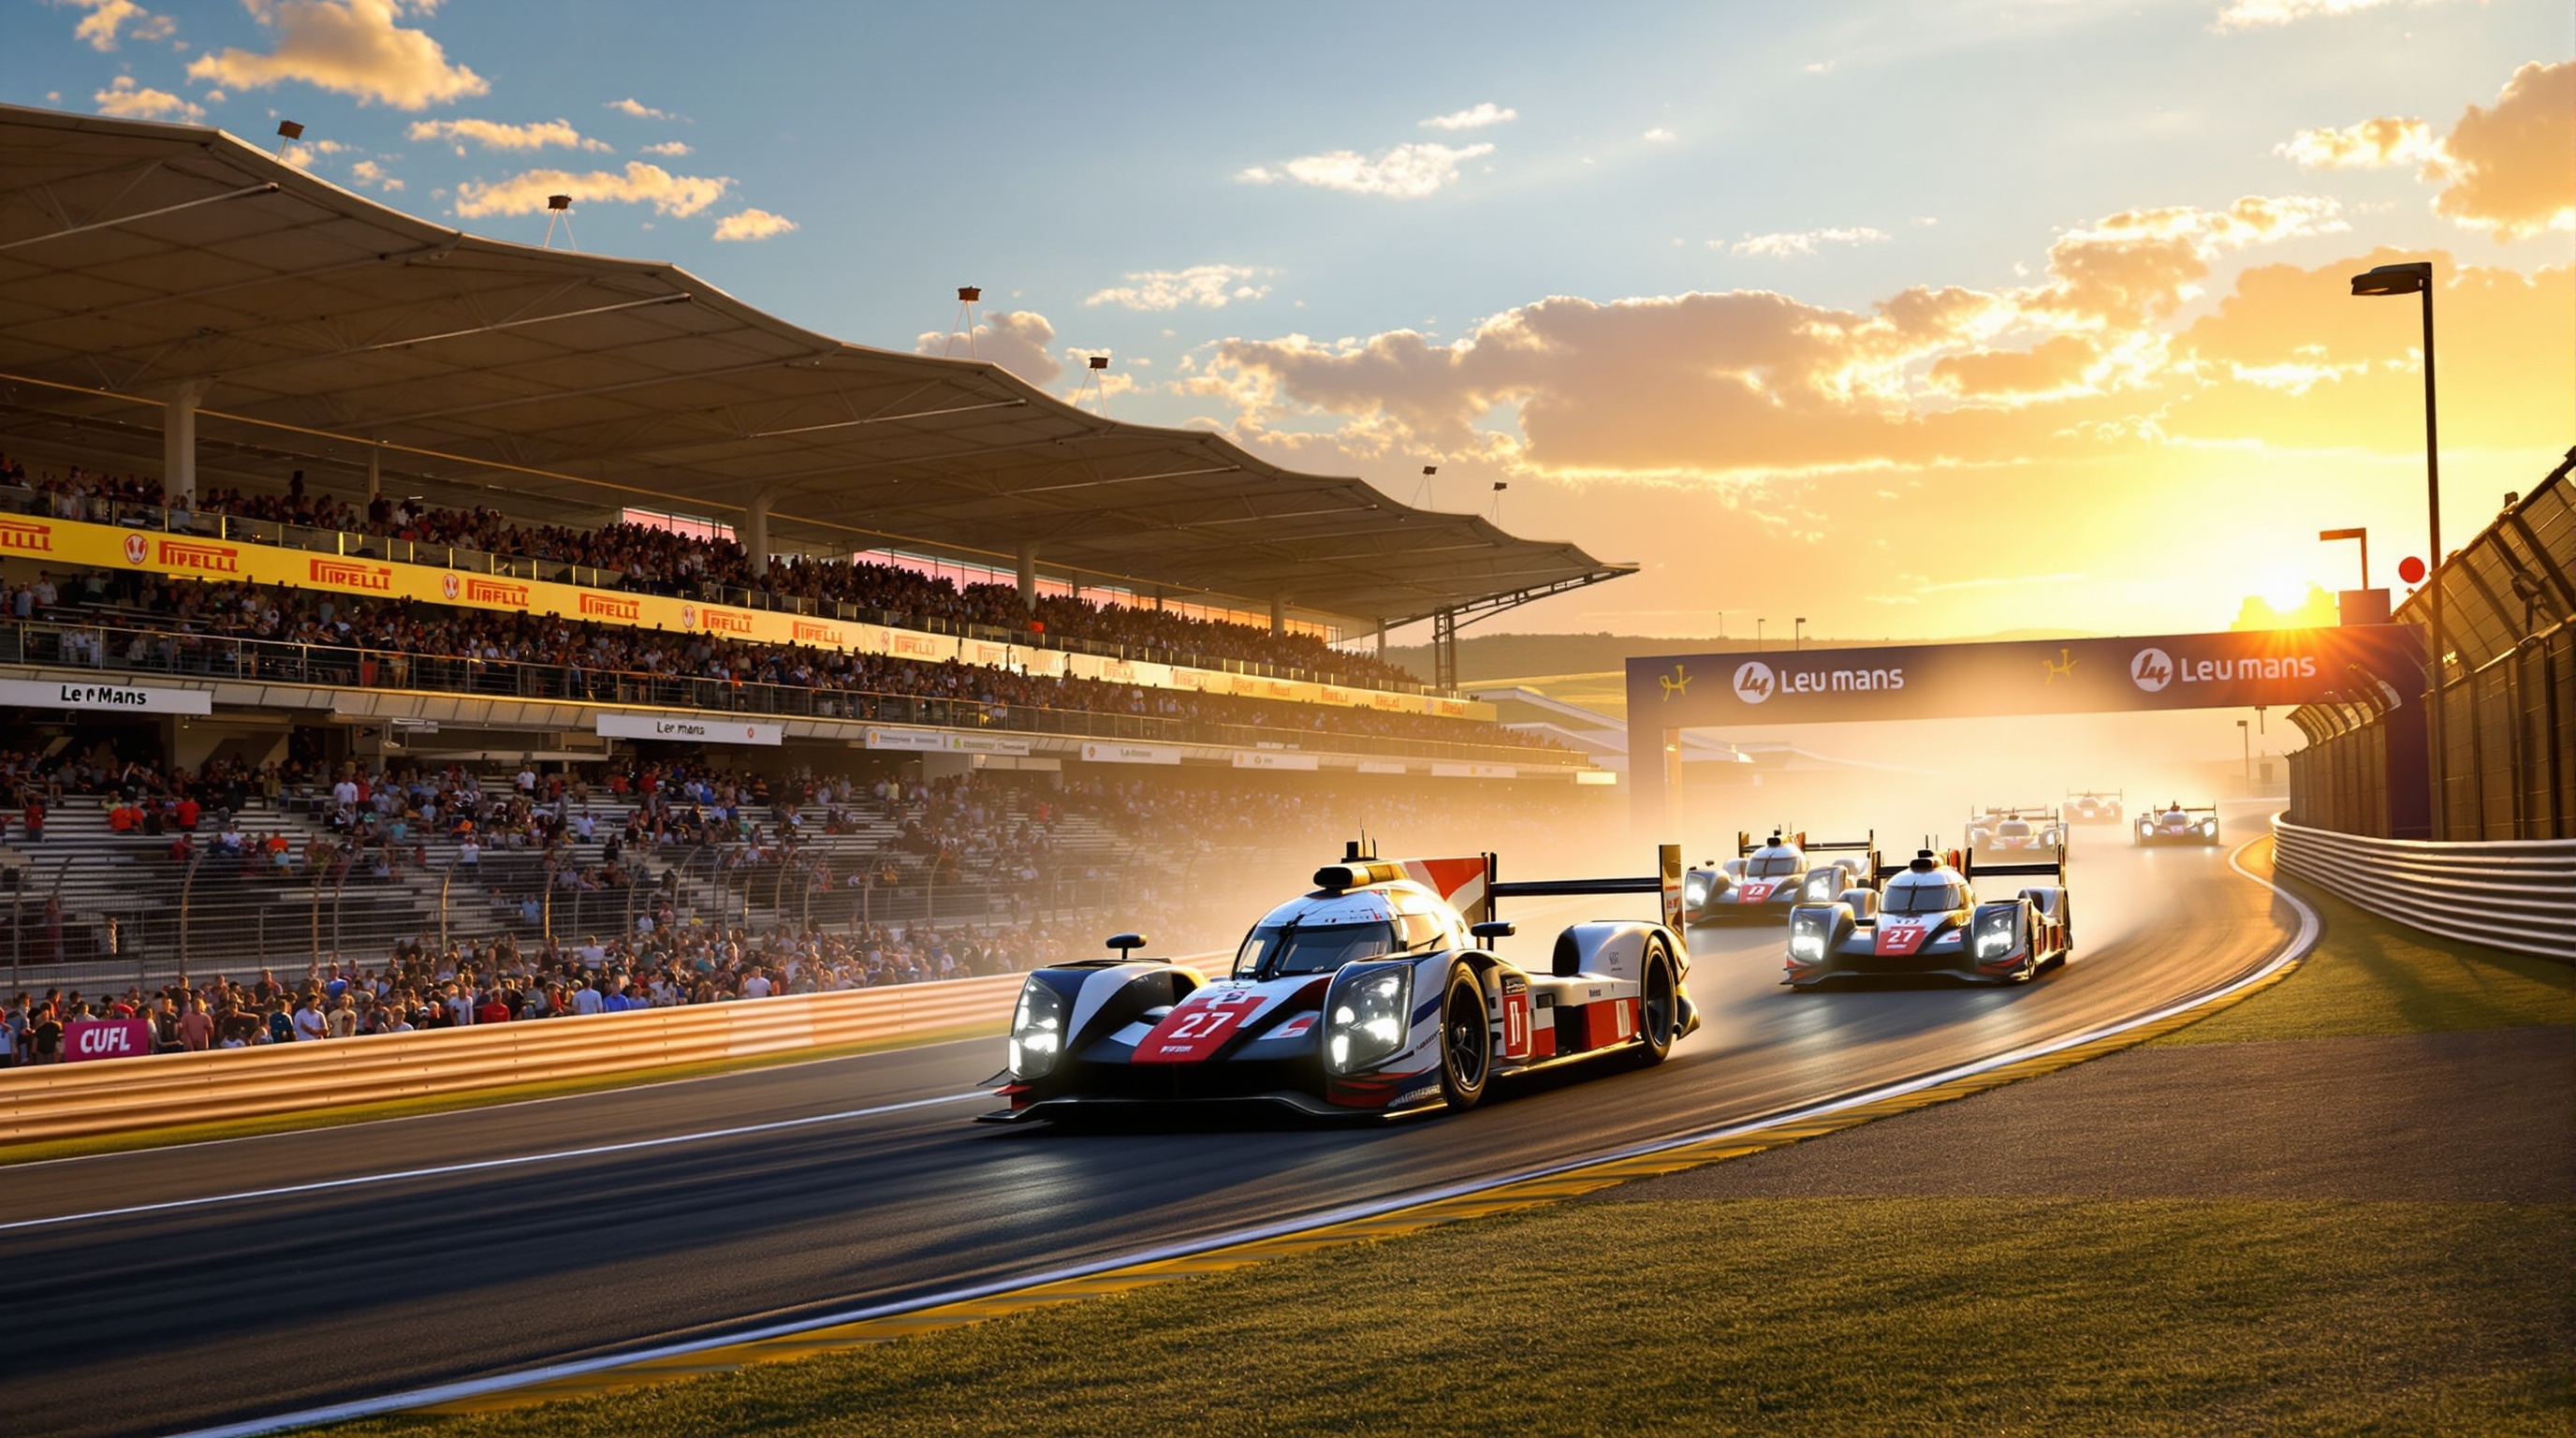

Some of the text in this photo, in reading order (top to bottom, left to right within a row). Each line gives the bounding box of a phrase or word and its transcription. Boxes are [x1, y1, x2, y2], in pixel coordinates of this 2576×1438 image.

[1781, 669, 1825, 693] Leu
[1832, 668, 1904, 691] mans
[2181, 658, 2232, 682] Leu
[2239, 656, 2316, 680] mans
[61, 685, 81, 701] Le
[98, 687, 147, 705] Mans
[1887, 930, 1917, 943] 27
[1168, 1011, 1235, 1038] 27
[80, 1027, 131, 1053] CUFL
